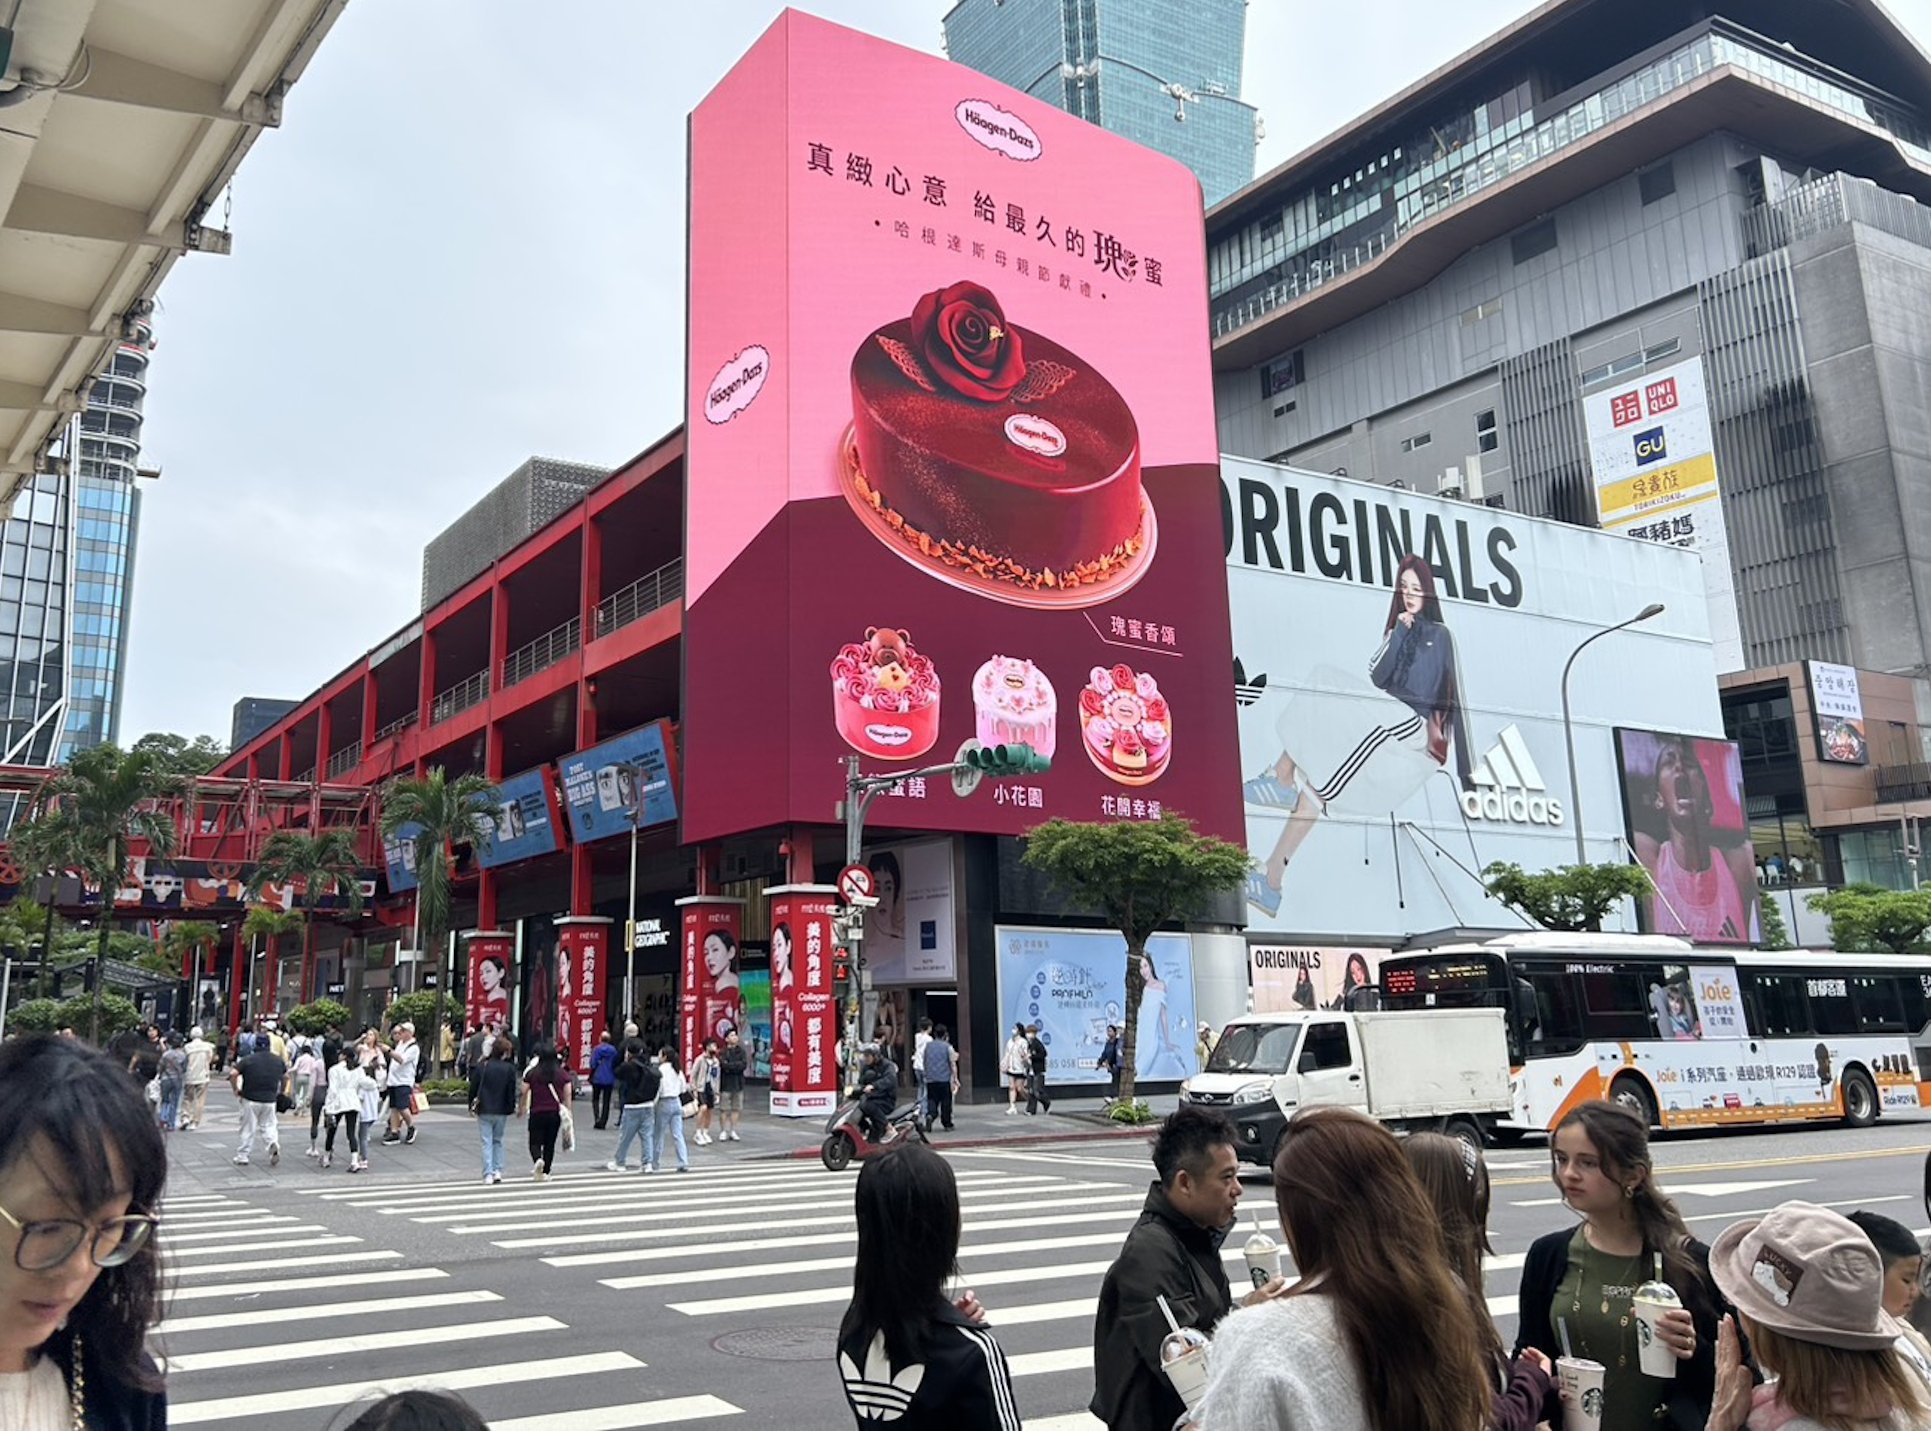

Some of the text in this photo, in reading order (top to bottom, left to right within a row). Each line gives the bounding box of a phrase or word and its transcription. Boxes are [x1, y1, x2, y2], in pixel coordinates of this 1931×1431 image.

[965, 107, 1034, 149] Häagen-Dazs
[807, 141, 947, 207] 真緻心意
[1637, 435, 1665, 457] GU
[994, 784, 1043, 808] 小花園
[1461, 784, 1564, 826] adidas
[1255, 950, 1321, 969] ORIGINALS
[1700, 978, 1732, 1001] Joie
[1656, 1067, 1677, 1083] Joie
